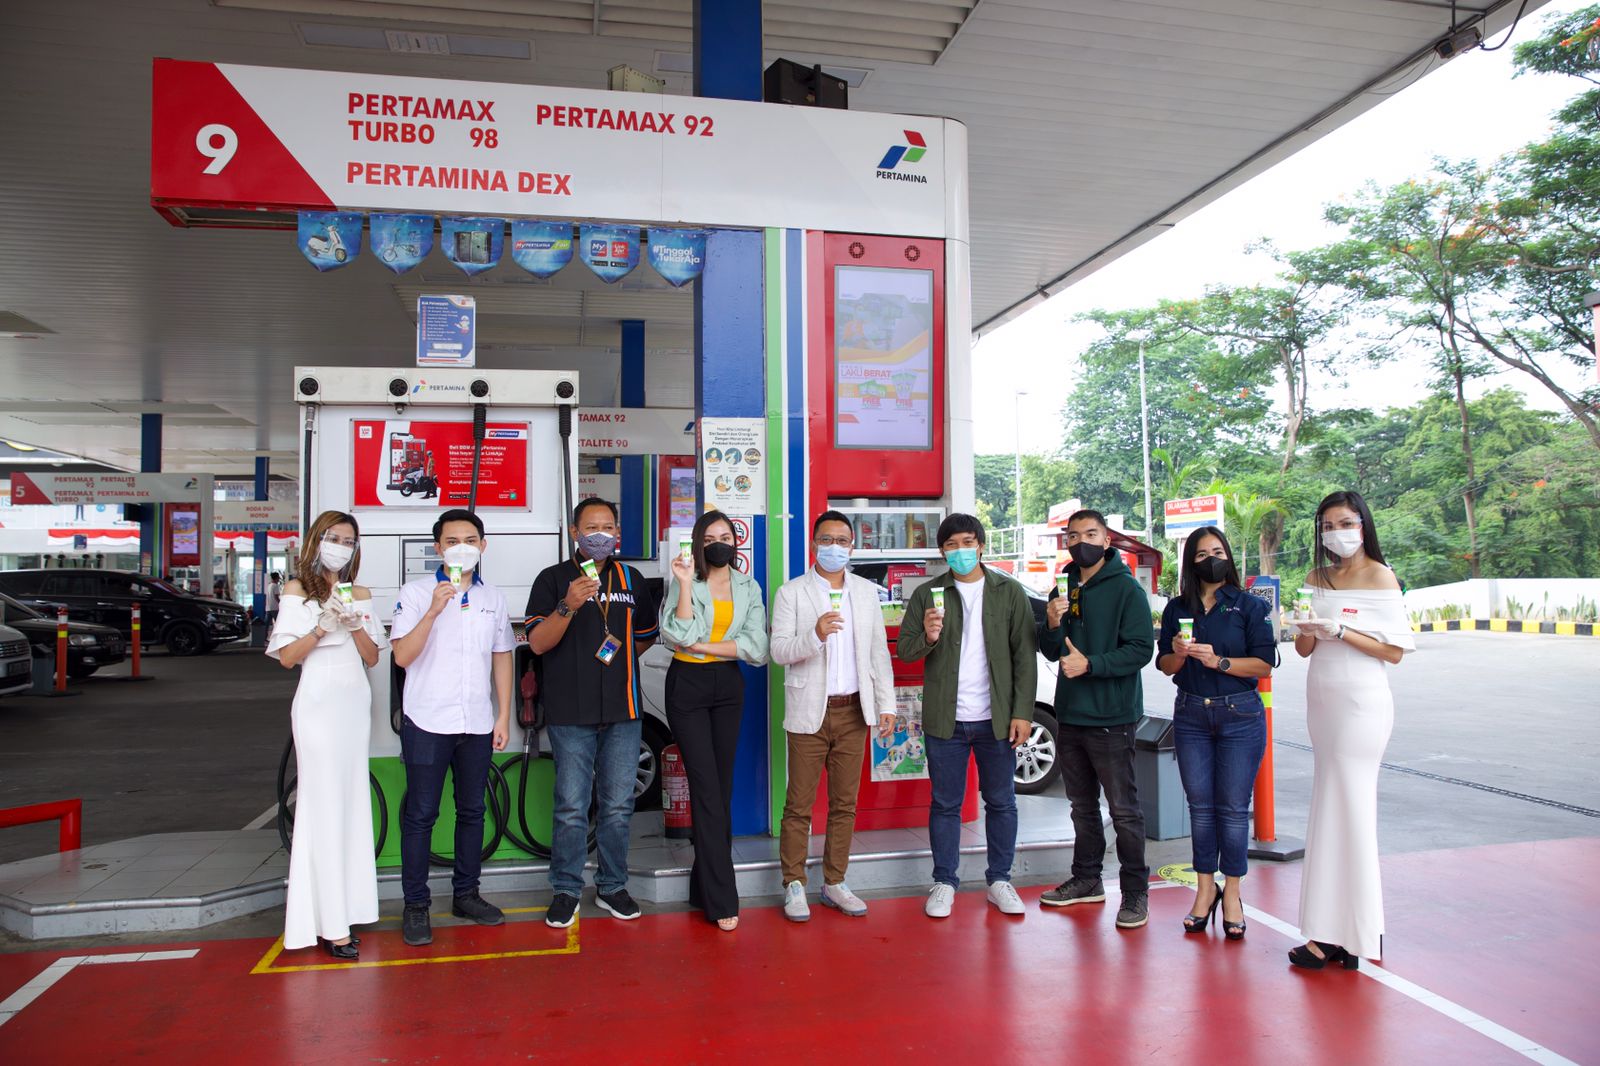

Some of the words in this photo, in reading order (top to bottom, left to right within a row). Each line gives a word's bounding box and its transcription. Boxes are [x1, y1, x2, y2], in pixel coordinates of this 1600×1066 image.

[348, 92, 496, 123] PERTAMAX
[535, 103, 676, 135] PERTAMAX
[683, 113, 715, 137] 92
[348, 120, 436, 146] TURBO
[469, 127, 499, 149] 98
[195, 122, 239, 175] 9
[346, 161, 509, 193] PERTAMINA
[518, 171, 572, 196] DEX
[876, 170, 928, 184] PERTAMINA
[591, 242, 605, 252] My
[652, 244, 693, 258] #Tinggal
[841, 367, 863, 377] LAKU
[863, 369, 892, 378] BERAT
[429, 384, 466, 393] PERTAMINA
[578, 413, 612, 423] TAMAX
[614, 413, 626, 423] 92
[578, 438, 613, 448] TALITE
[615, 439, 629, 448] 90
[54, 476, 95, 484] PERTAMAX
[100, 476, 136, 484] PERTALITE
[15, 485, 26, 499] 5
[97, 490, 136, 498] PERTAMINA
[587, 591, 636, 605] AMINA
